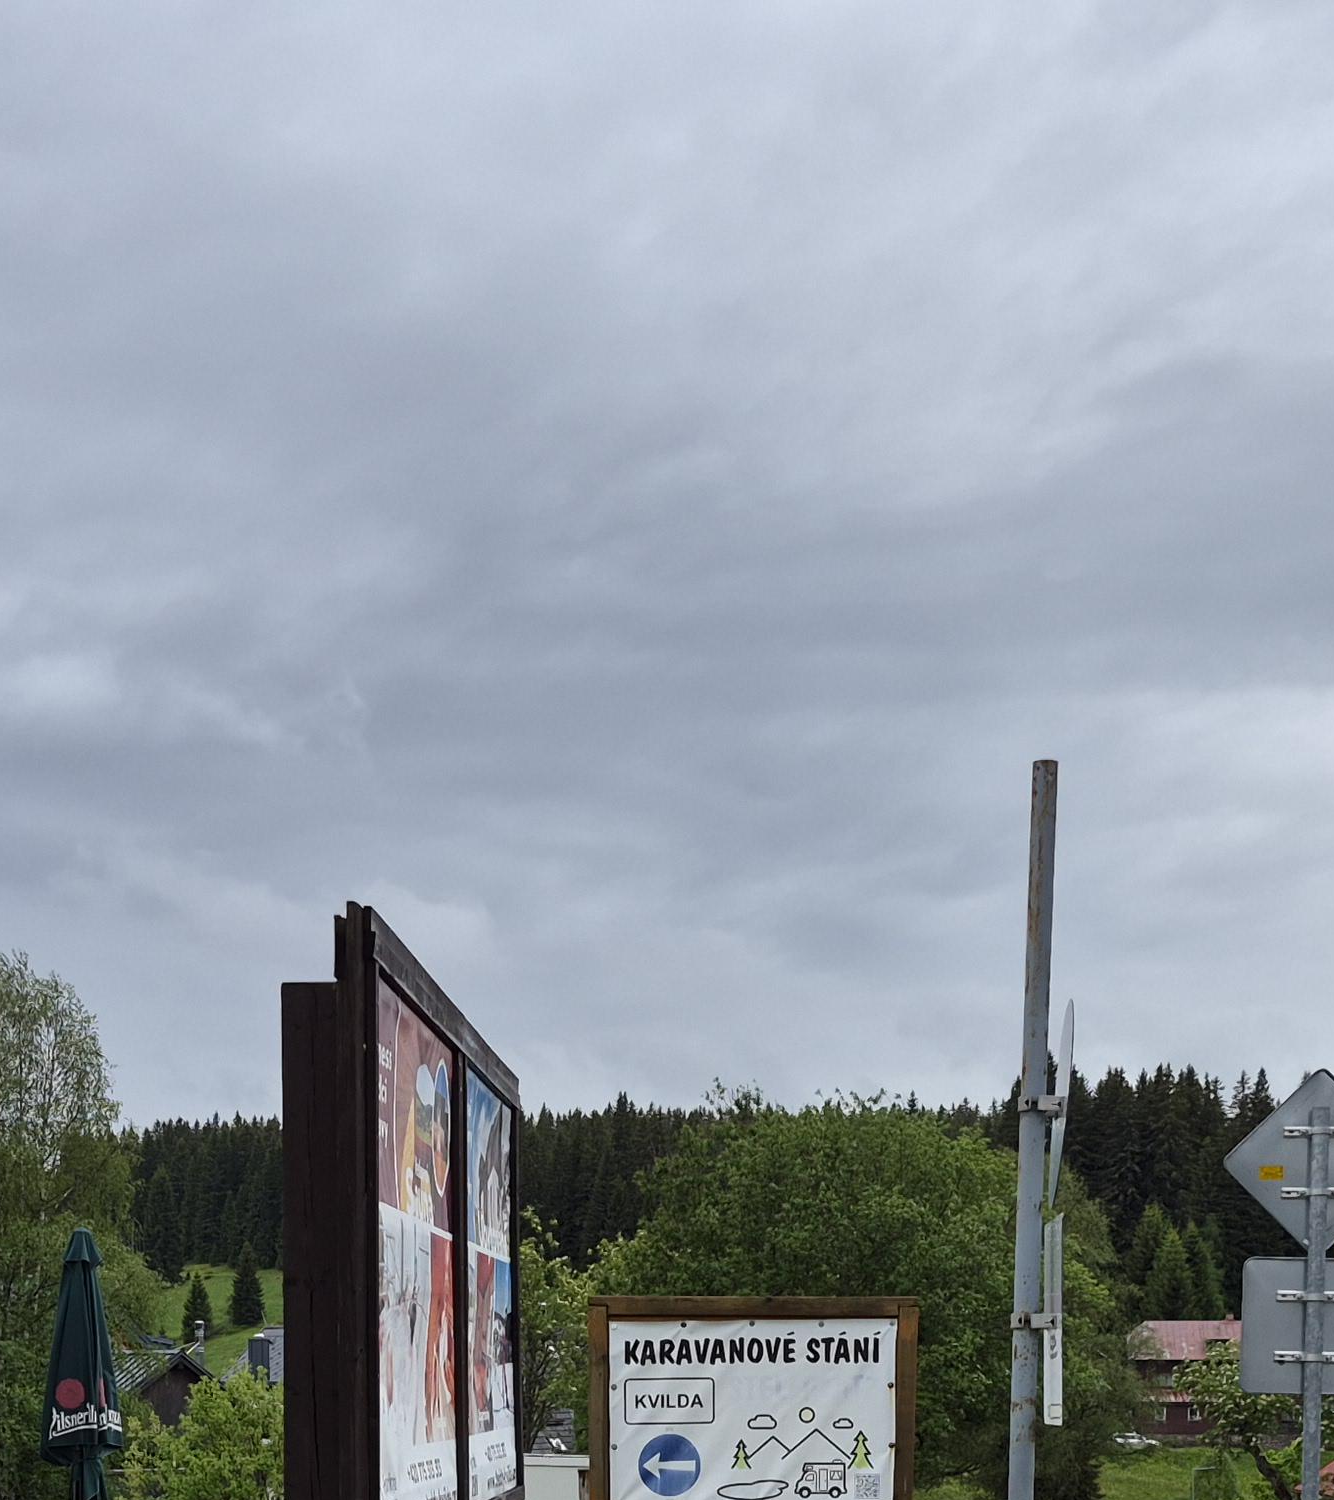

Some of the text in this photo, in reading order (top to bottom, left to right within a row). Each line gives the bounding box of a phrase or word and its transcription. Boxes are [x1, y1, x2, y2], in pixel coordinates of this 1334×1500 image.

[624, 1331, 881, 1365] KARAVANOVÉ STÁNÍ
[634, 1393, 704, 1409] KVILDA
